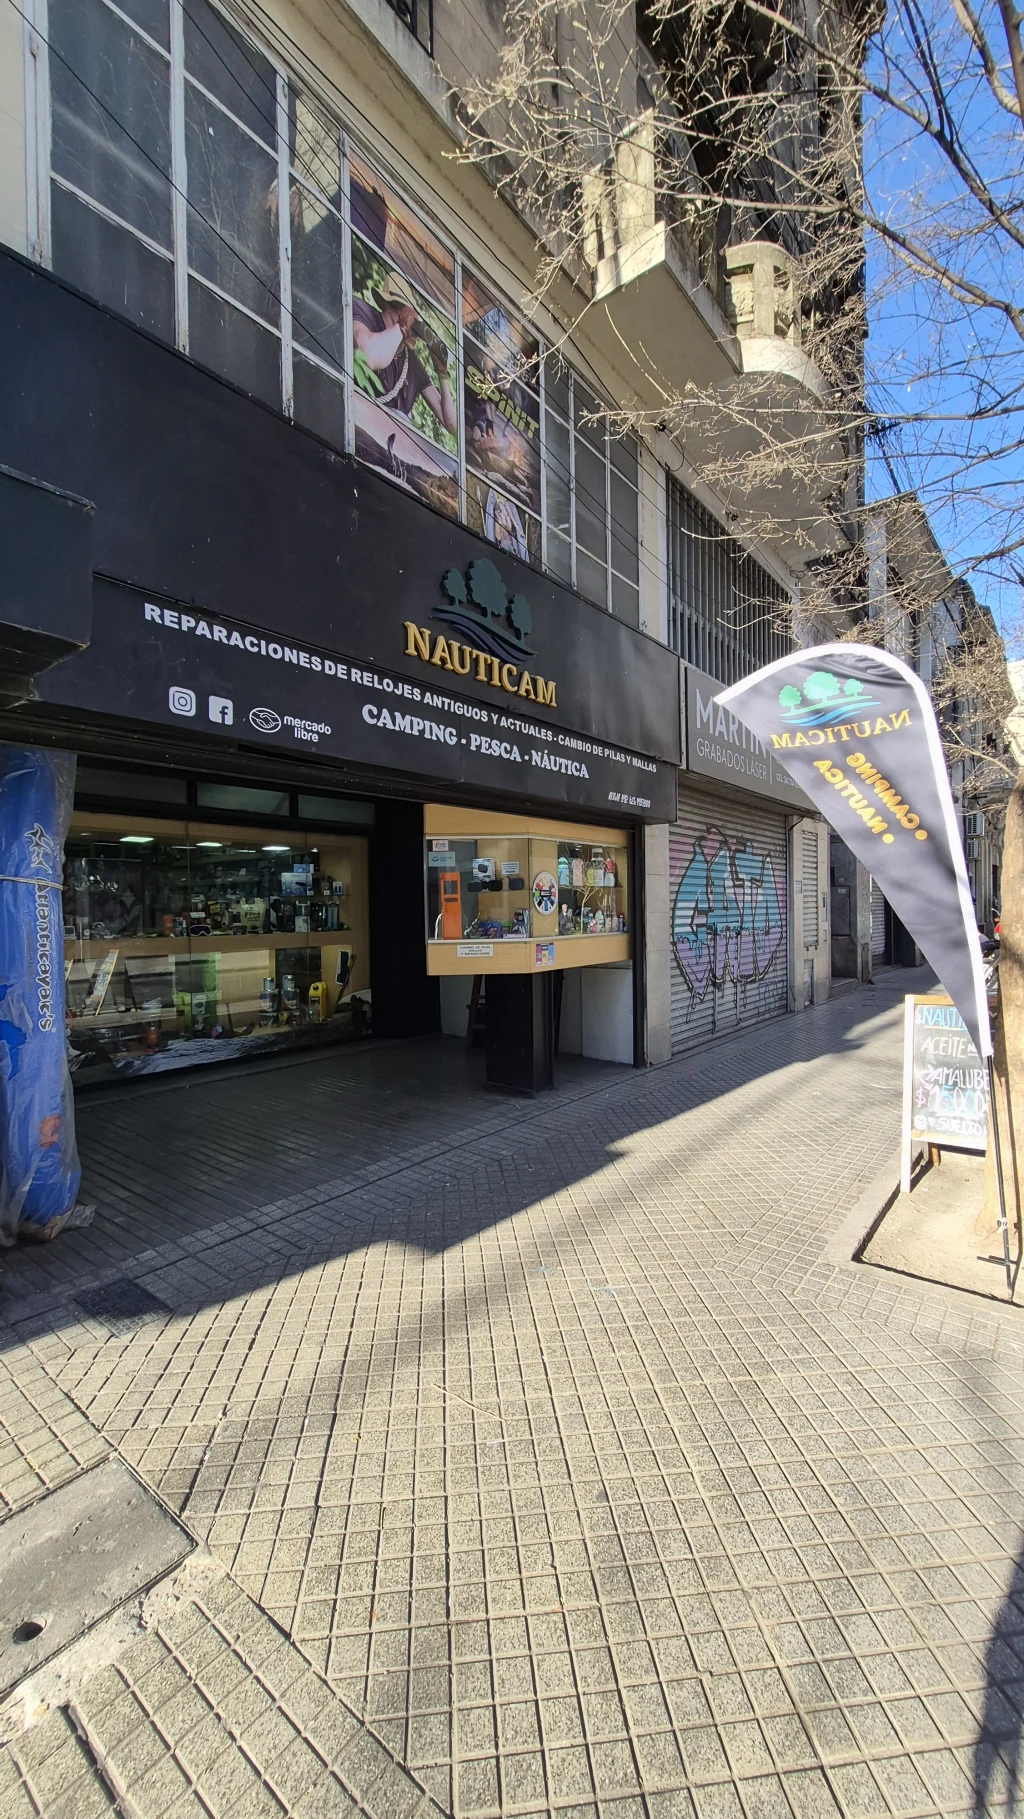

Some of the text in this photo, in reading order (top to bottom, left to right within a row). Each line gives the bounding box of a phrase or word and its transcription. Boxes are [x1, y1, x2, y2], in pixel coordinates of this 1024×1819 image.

[402, 620, 558, 708] NAUTICAM
[144, 602, 322, 672] REPARACIONES
[324, 659, 348, 680] DE
[350, 667, 421, 701] RELOJES
[423, 692, 488, 723] ANTIGUOS
[491, 712, 499, 725] Y
[500, 716, 553, 741] ACTUALES
[558, 734, 592, 753] CAMBIO
[592, 744, 603, 756] DE
[604, 746, 626, 763] PILAS
[626, 753, 632, 764] Y
[632, 757, 657, 773] MALLAS
[283, 715, 332, 735] mercado
[294, 727, 319, 743] libre
[361, 704, 457, 746] CAMPING
[469, 733, 522, 763] PESCA
[531, 749, 590, 779] NÁUTICA
[696, 738, 768, 780] GRABADOS LÁSER
[921, 1034, 967, 1058] ACEITE
